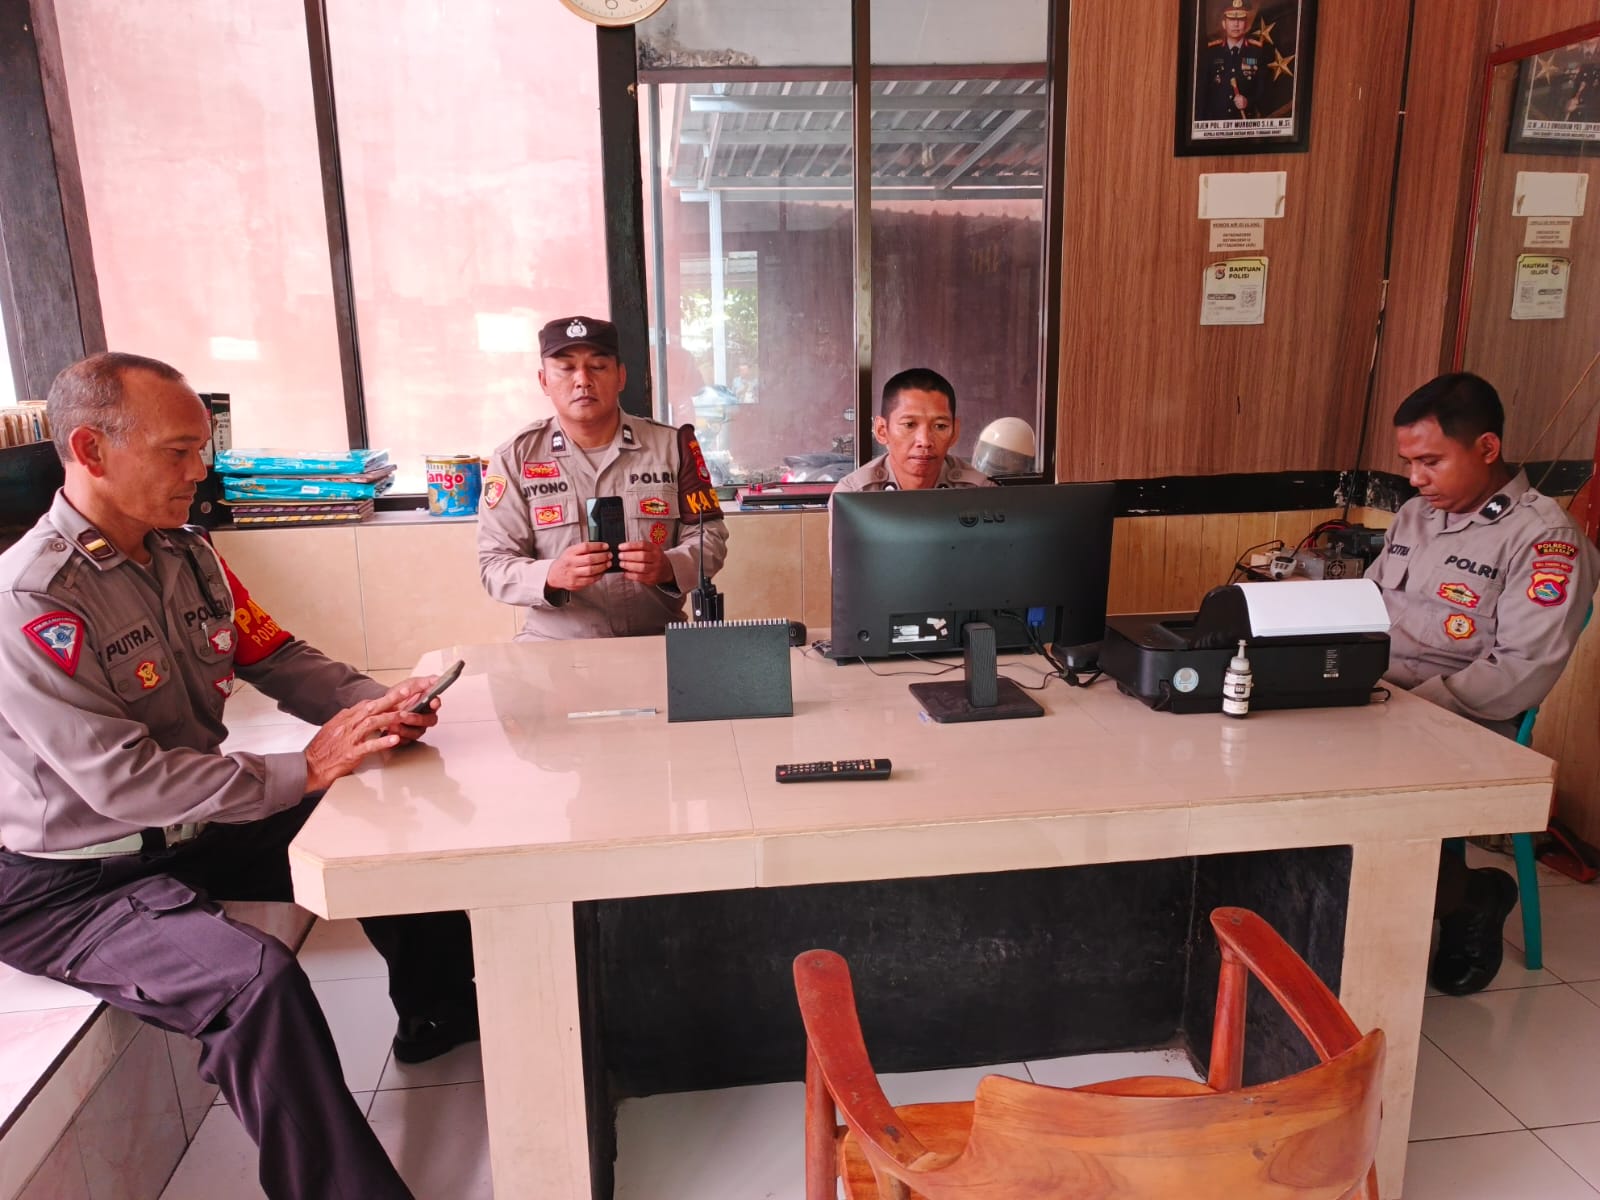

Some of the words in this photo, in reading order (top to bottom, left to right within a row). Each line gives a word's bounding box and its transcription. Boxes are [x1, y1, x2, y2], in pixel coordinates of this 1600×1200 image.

[427, 472, 464, 490] ango
[630, 471, 675, 485] POLRI
[1444, 555, 1499, 580] POLRI
[106, 624, 155, 663] PUTRA
